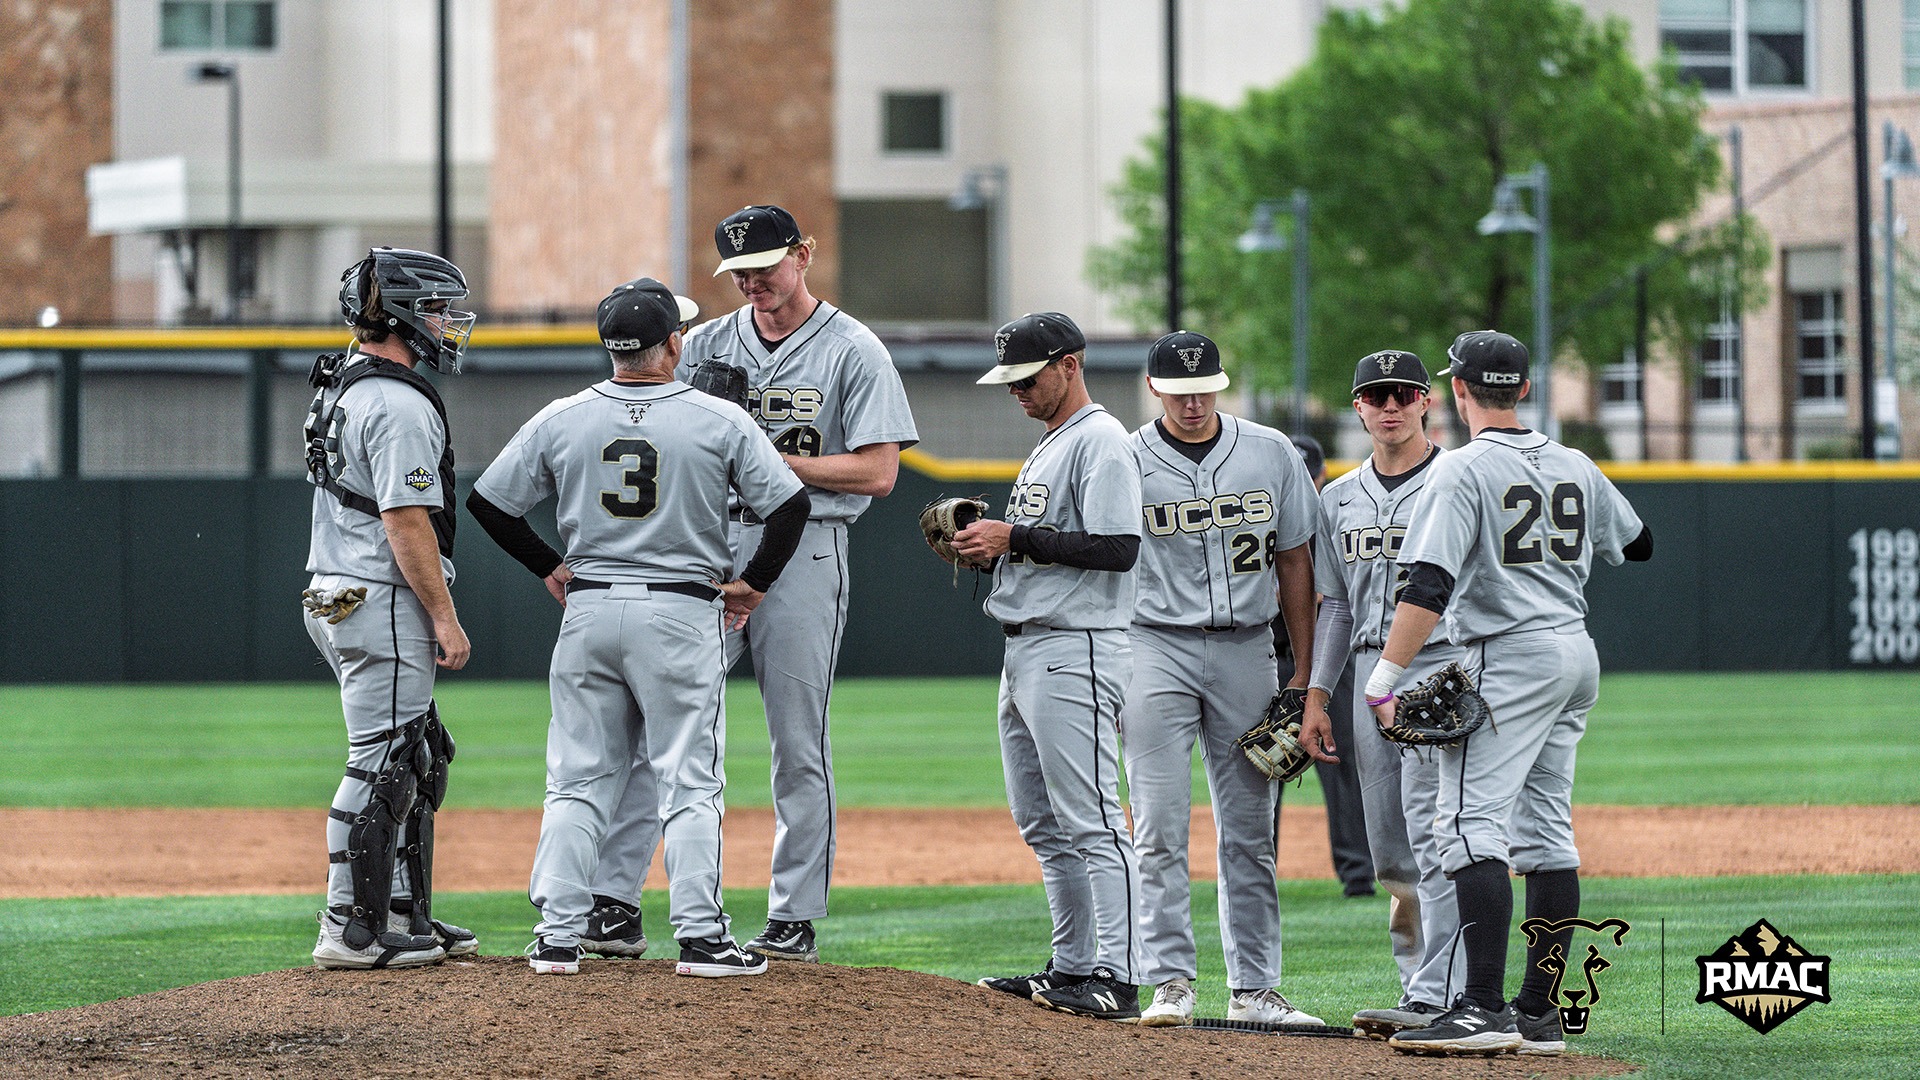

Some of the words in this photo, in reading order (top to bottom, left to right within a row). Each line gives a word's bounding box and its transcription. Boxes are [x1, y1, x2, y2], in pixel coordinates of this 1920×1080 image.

[604, 338, 641, 351] UCCS
[1482, 371, 1520, 385] UCCS
[772, 425, 823, 458] 49
[407, 475, 433, 485] RMAC
[600, 437, 660, 520] 3
[1142, 488, 1275, 539] UCCS
[1501, 482, 1585, 566] 29
[1230, 530, 1278, 575] 28
[1339, 525, 1408, 566] UCC
[1850, 627, 1920, 663] 200
[1091, 991, 1119, 1011] N
[1453, 1014, 1487, 1031] N
